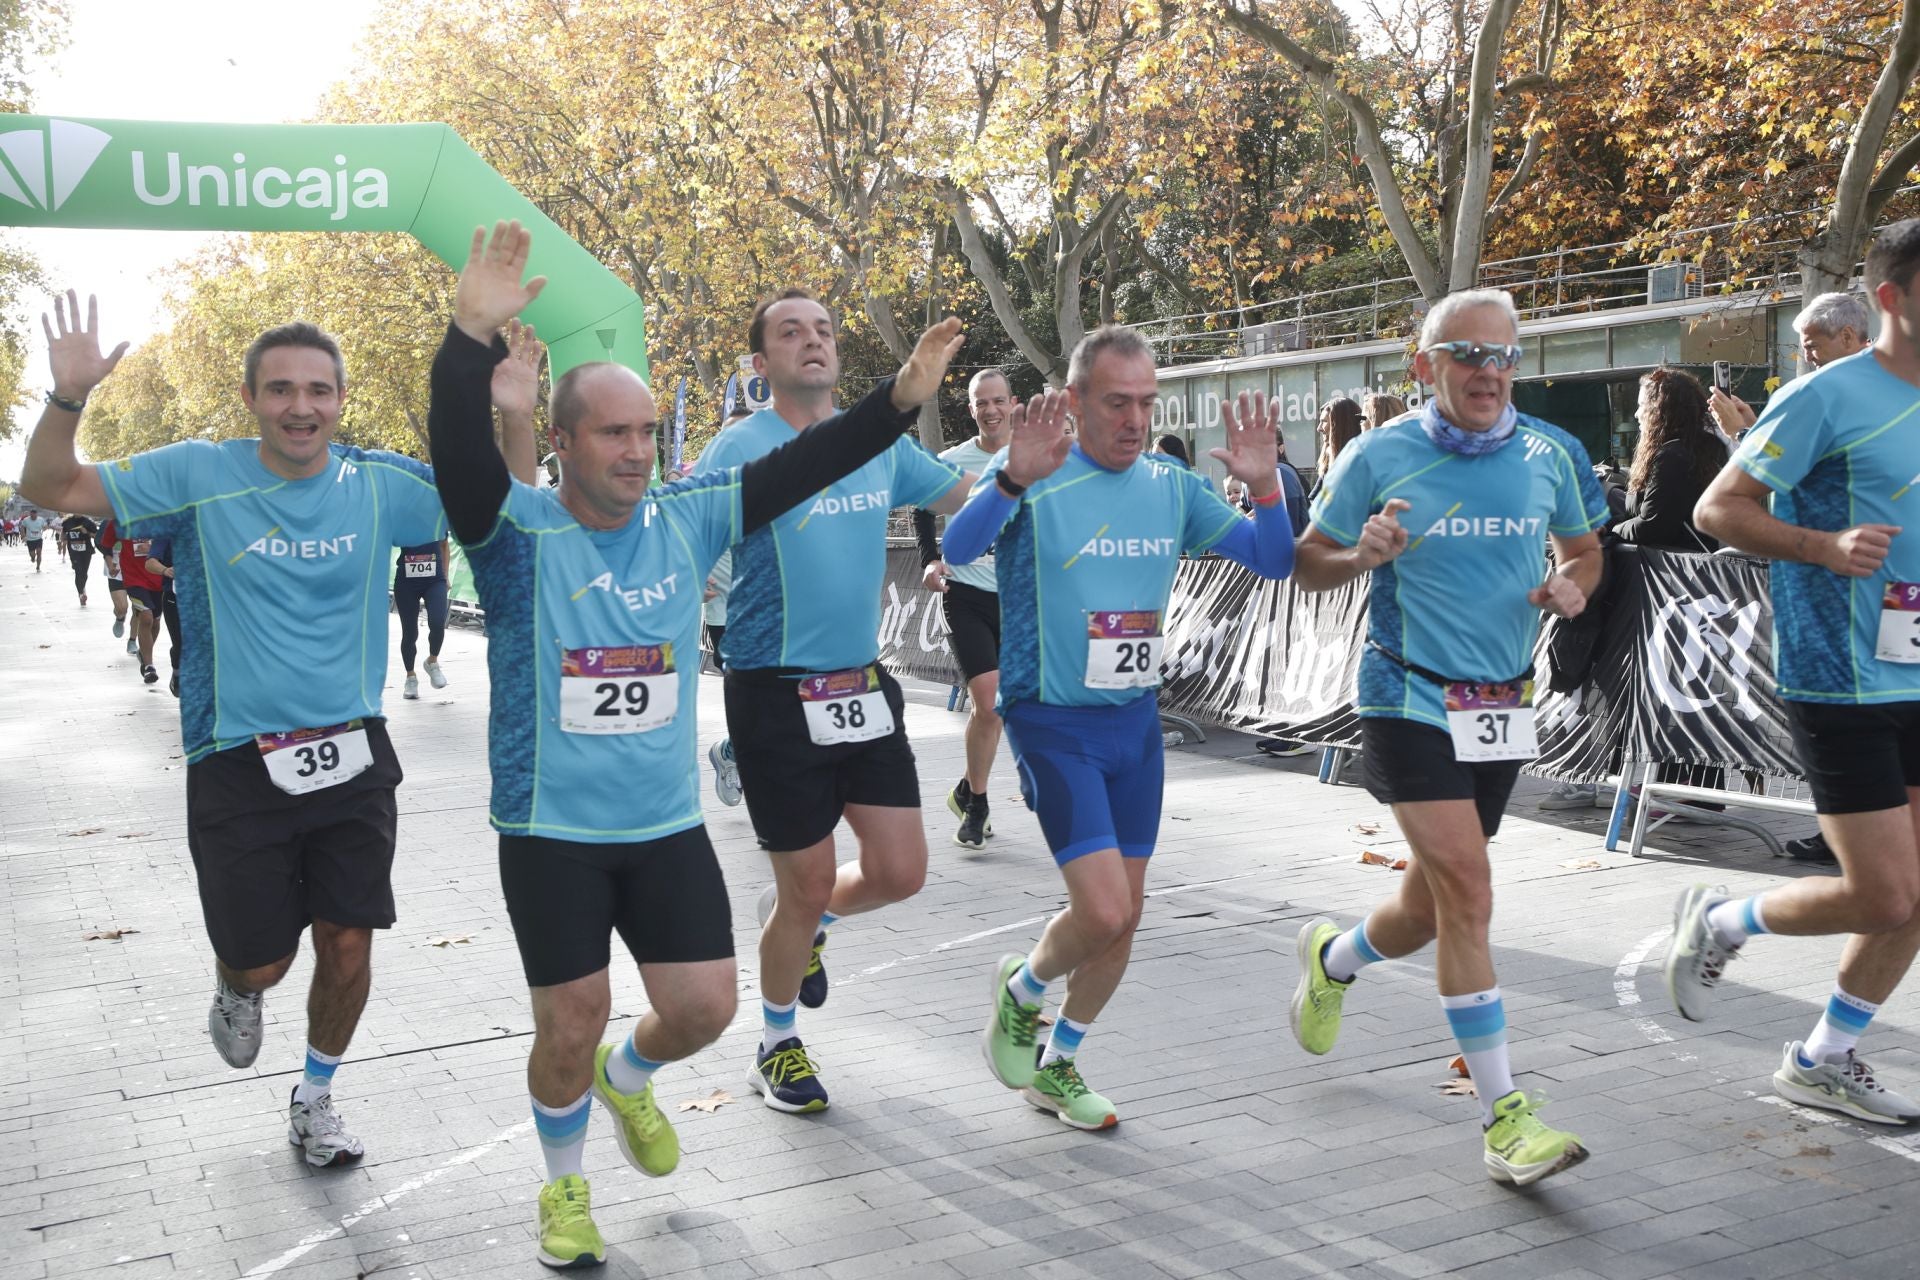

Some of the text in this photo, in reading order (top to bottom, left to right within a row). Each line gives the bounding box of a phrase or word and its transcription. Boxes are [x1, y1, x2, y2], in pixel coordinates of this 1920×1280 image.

[131, 150, 388, 221] Unicaja
[1151, 392, 1220, 431] DOLID
[809, 490, 889, 515] ADIENT
[1424, 517, 1541, 537] ADIENT
[246, 534, 357, 558] ADIENT
[1079, 538, 1174, 557] ADIENT
[410, 564, 432, 573] 704
[1115, 642, 1151, 673] 28
[593, 681, 649, 716] 29
[826, 699, 866, 729] 38
[1476, 713, 1510, 745] 37
[294, 741, 340, 777] 39
